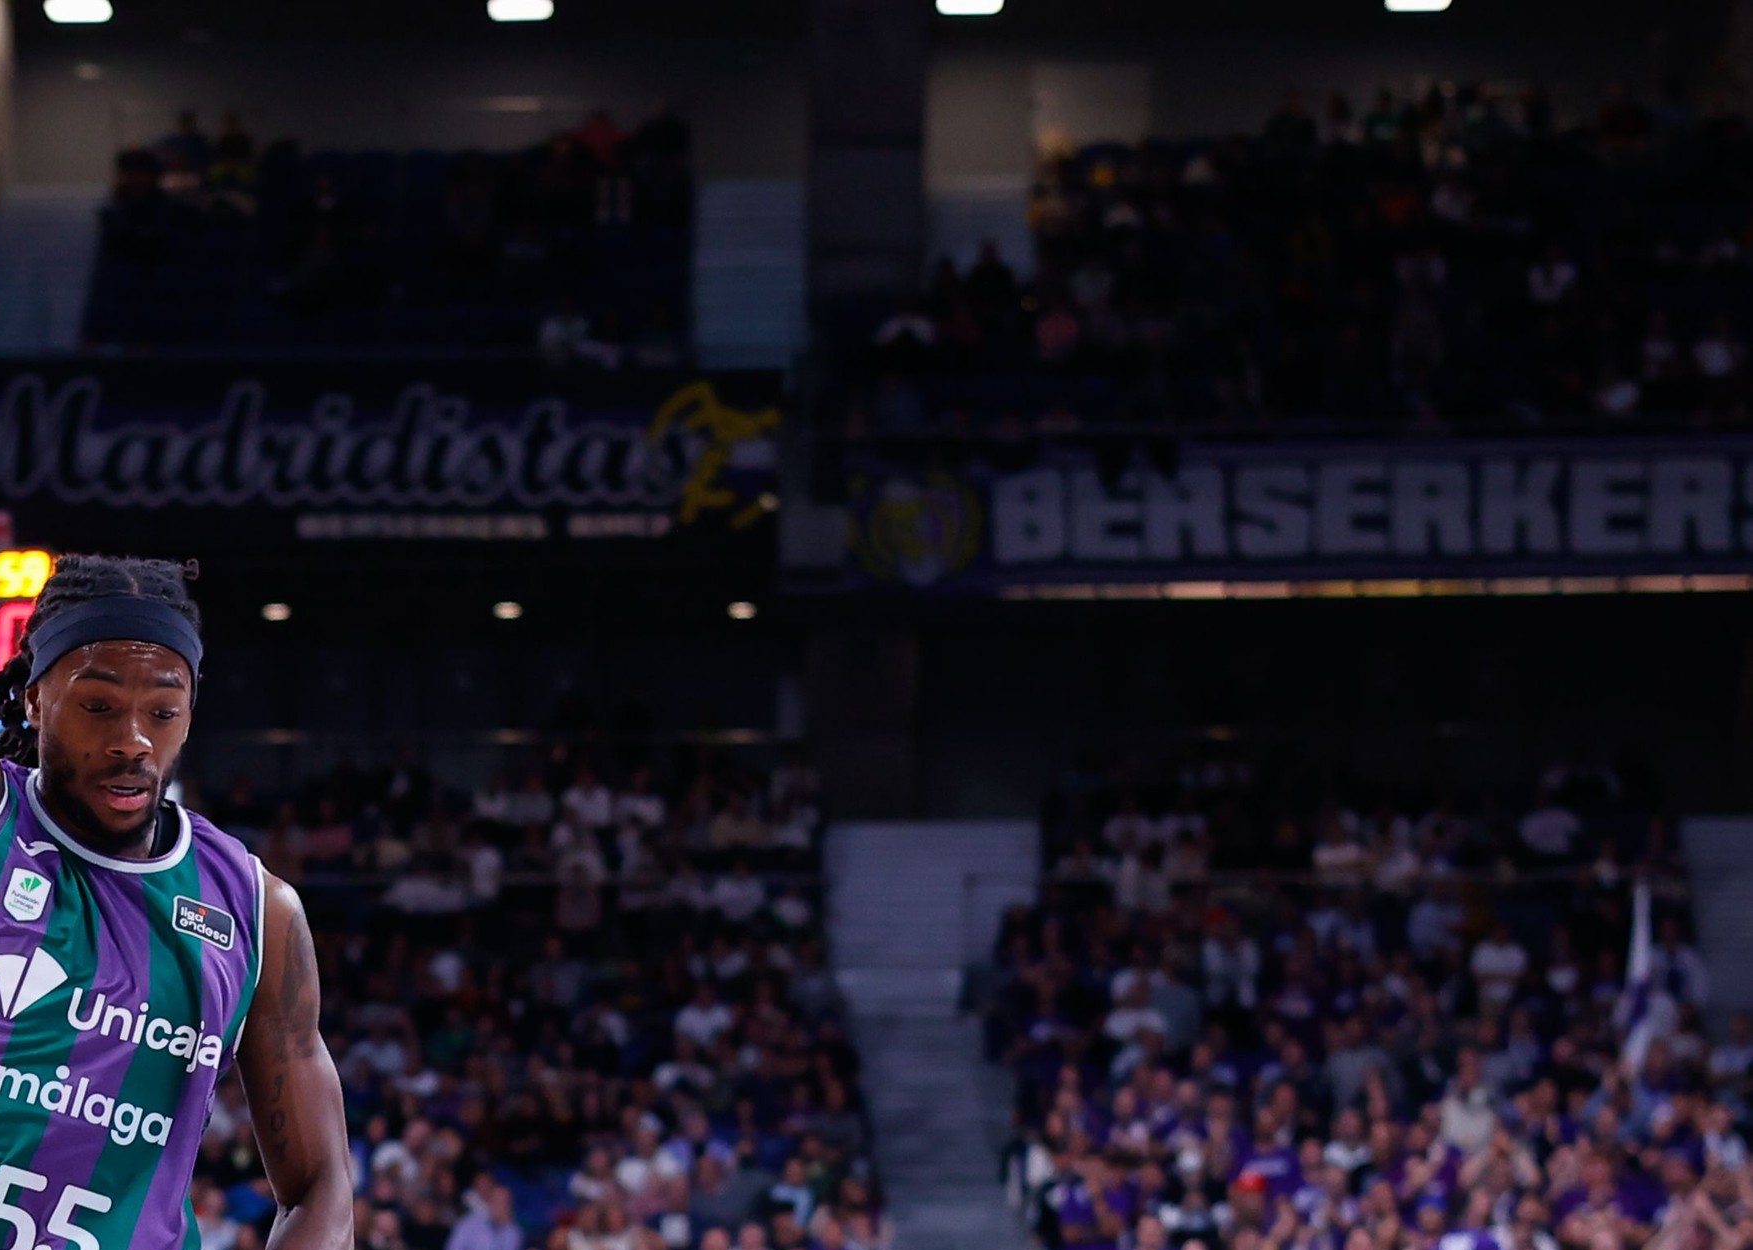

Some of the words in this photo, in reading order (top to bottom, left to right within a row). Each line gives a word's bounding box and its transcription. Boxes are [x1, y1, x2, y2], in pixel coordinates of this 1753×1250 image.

[180, 906, 204, 923] liga
[179, 917, 228, 944] endesa
[67, 987, 222, 1073] Unicaja
